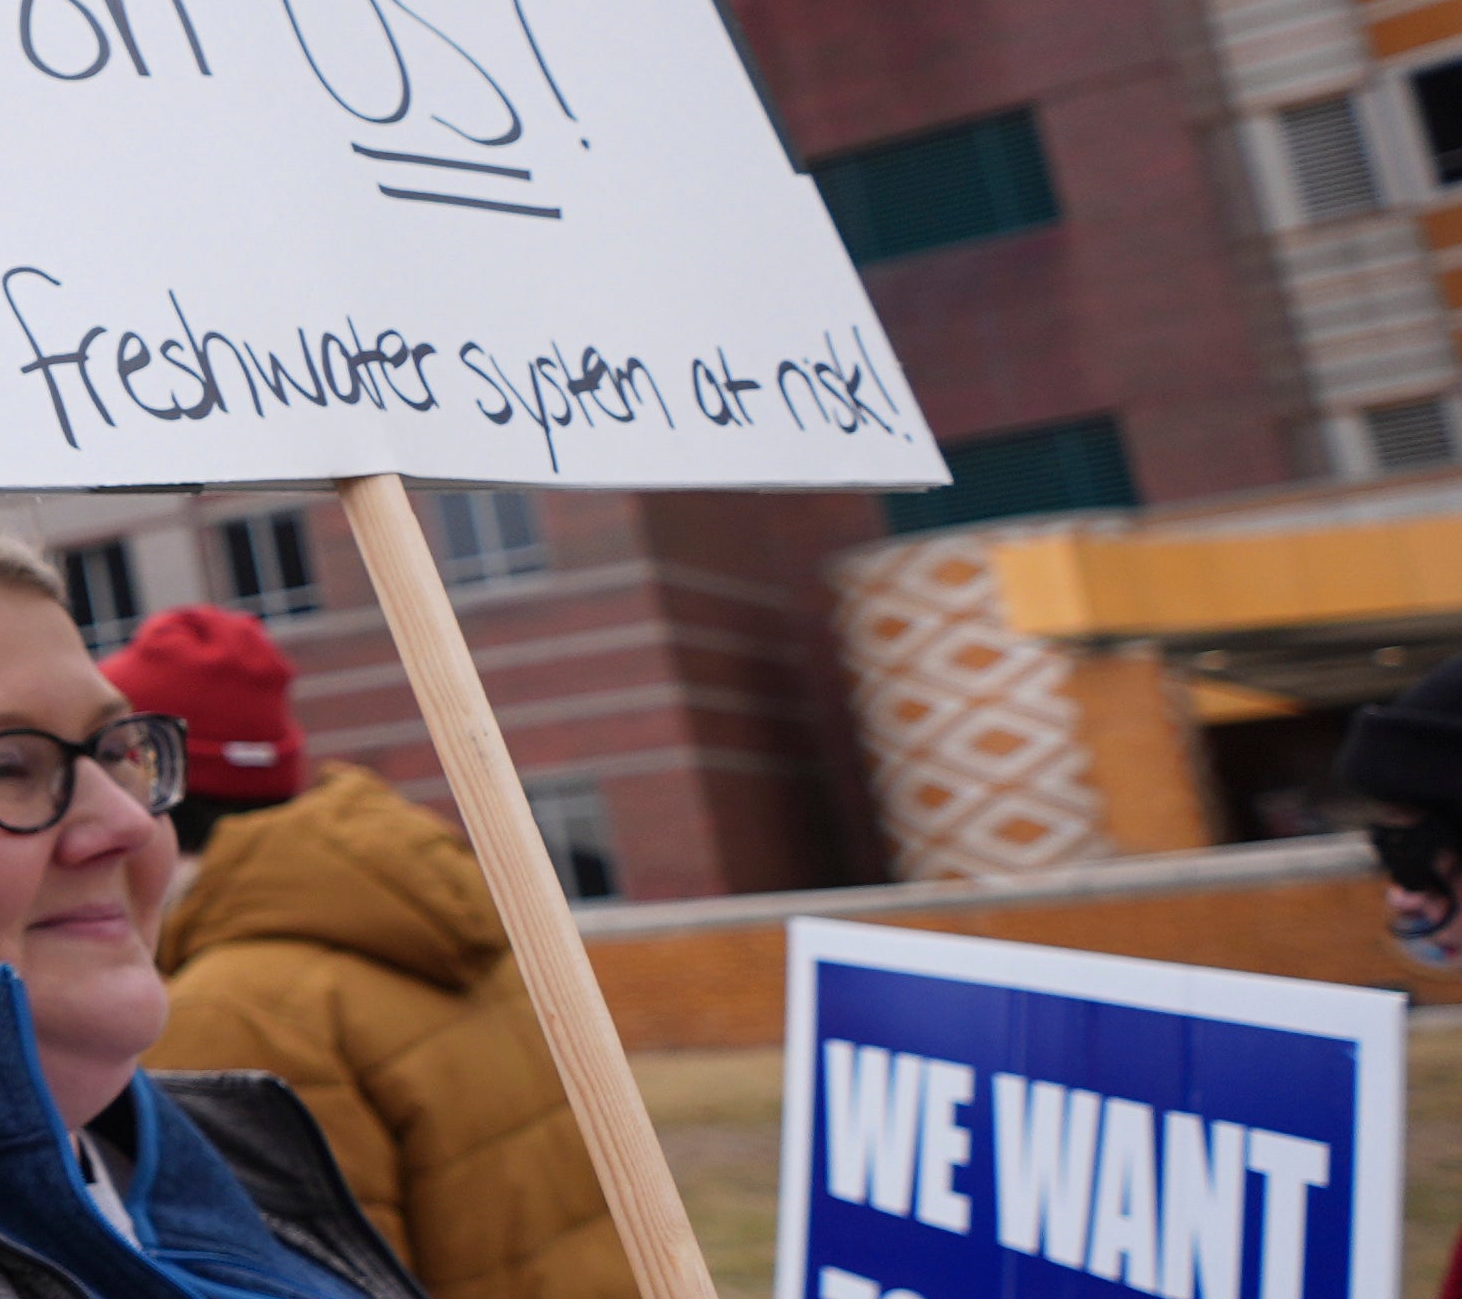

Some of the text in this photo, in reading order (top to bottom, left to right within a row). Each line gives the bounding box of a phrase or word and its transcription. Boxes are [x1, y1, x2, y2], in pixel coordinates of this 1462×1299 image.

[1, 266, 438, 449] freshwater
[459, 340, 675, 474] system
[691, 347, 761, 428] at
[774, 324, 914, 443] risk!
[823, 1038, 976, 1235] WE
